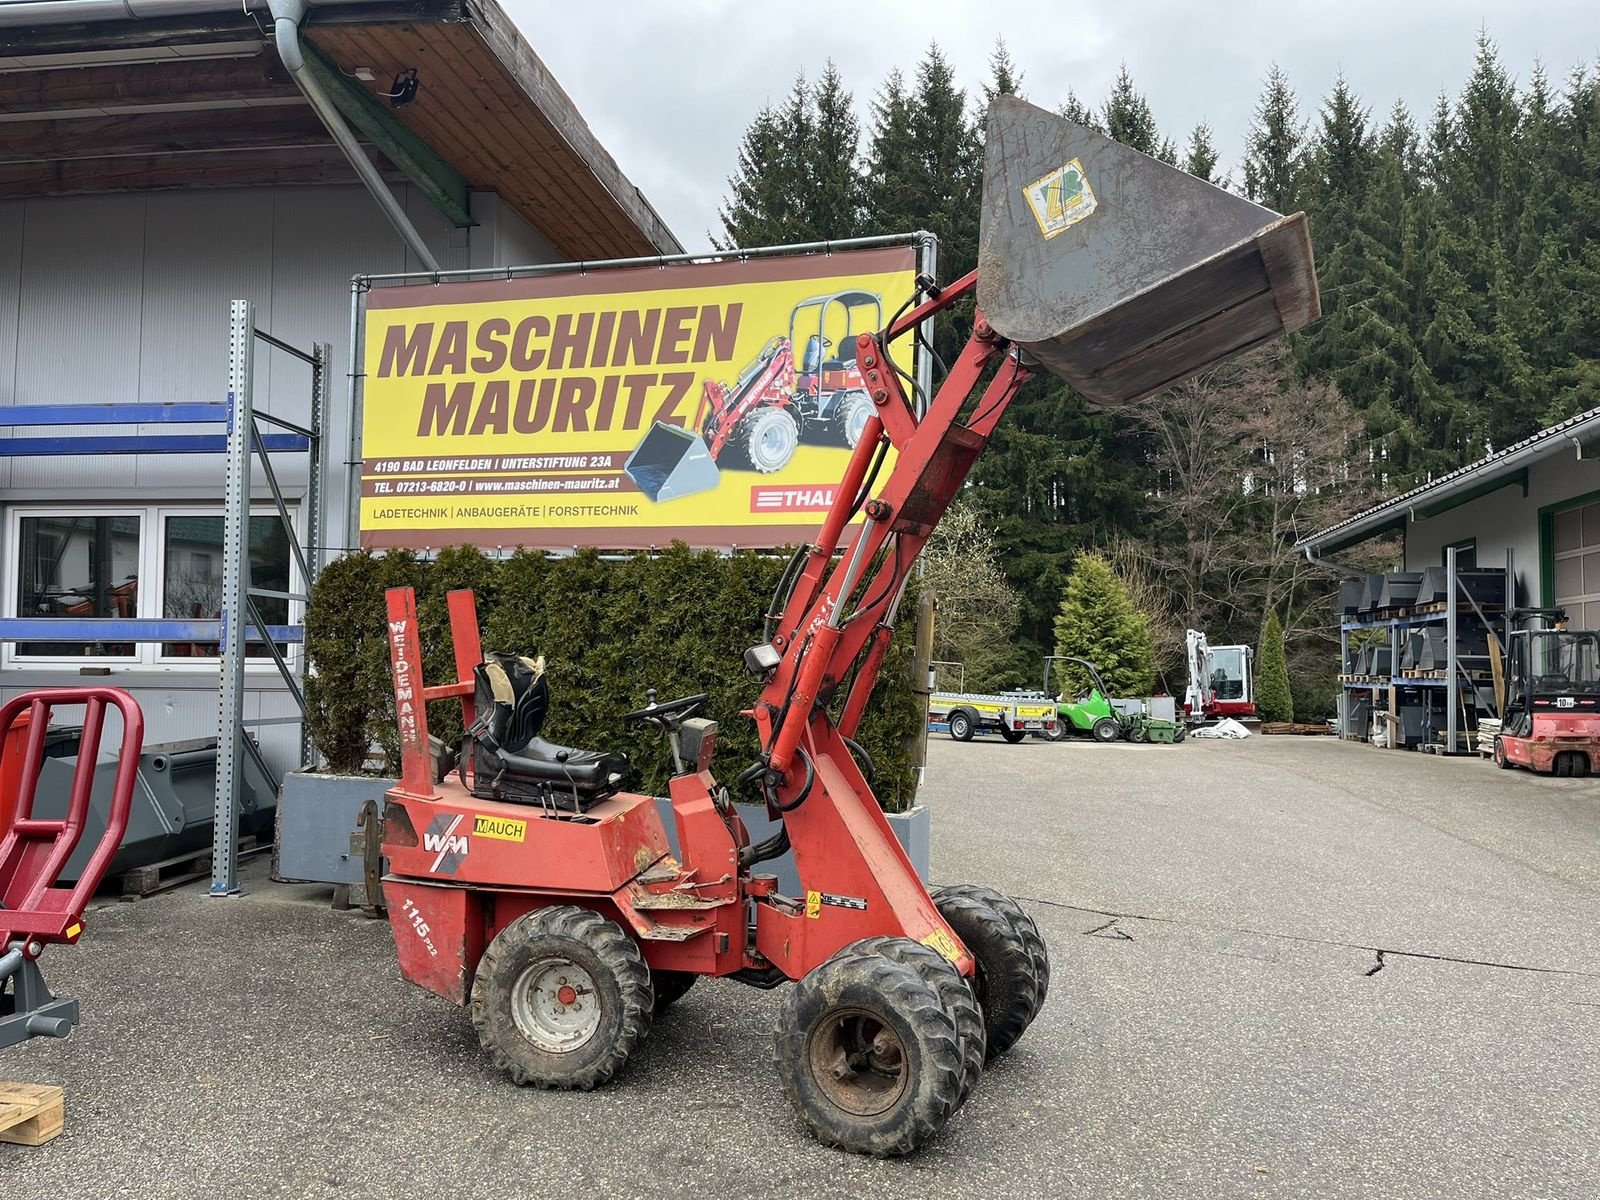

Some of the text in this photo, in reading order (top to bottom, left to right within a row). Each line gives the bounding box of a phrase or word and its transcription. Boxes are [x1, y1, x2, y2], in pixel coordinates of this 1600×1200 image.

[377, 302, 744, 378] MASCHINEN
[416, 372, 695, 437] MAURITZ
[374, 455, 612, 473] 4190 BAD LEONFELDEN UNTERSTIFTUNG 23A
[374, 477, 620, 493] TEL. 07213-6820-0 www.maschinen-mauritz.at
[373, 504, 639, 519] LADETECHNIK ANBAUGERÄTE FORSTTECHNIK
[1559, 699, 1567, 707] 10
[475, 818, 524, 838] MAUCH
